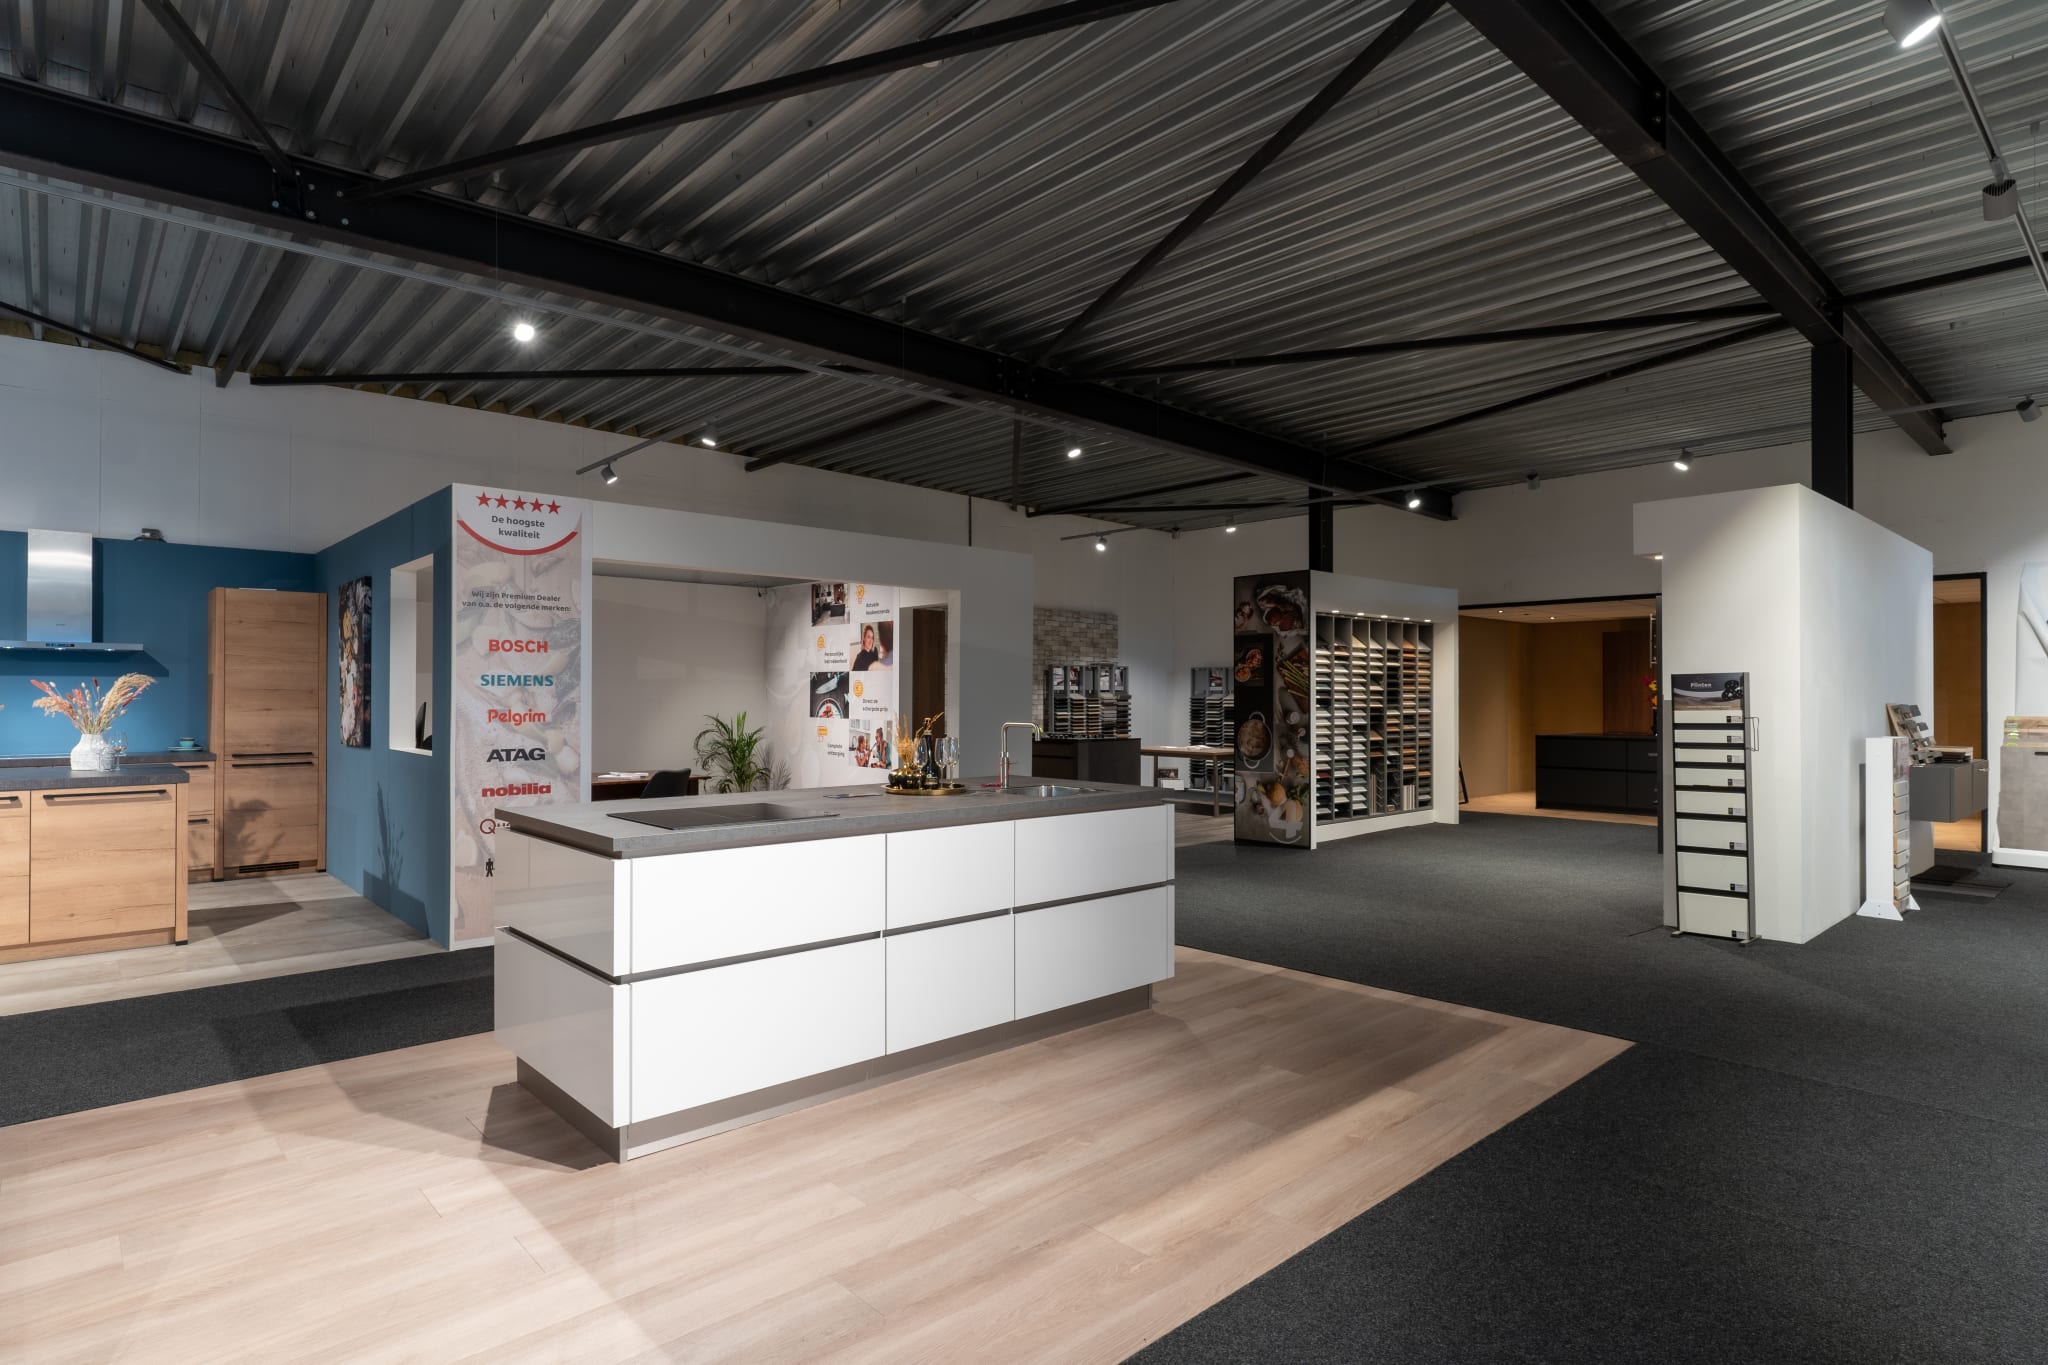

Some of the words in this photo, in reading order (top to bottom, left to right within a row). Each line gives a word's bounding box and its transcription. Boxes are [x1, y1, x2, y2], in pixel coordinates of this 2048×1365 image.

[491, 515, 505, 524] De
[506, 516, 545, 528] hoogste
[498, 527, 541, 539] kwaliteit
[471, 590, 484, 599] Wij
[485, 591, 500, 600] zijn
[501, 592, 535, 600] Premium
[536, 594, 561, 602] Dealer
[504, 602, 540, 611] volgende
[488, 639, 548, 653] BOSCH
[480, 674, 554, 687] SIEMENS
[487, 708, 546, 727] Pelgrim
[486, 747, 546, 763] ATAG
[481, 783, 552, 798] nobilia
